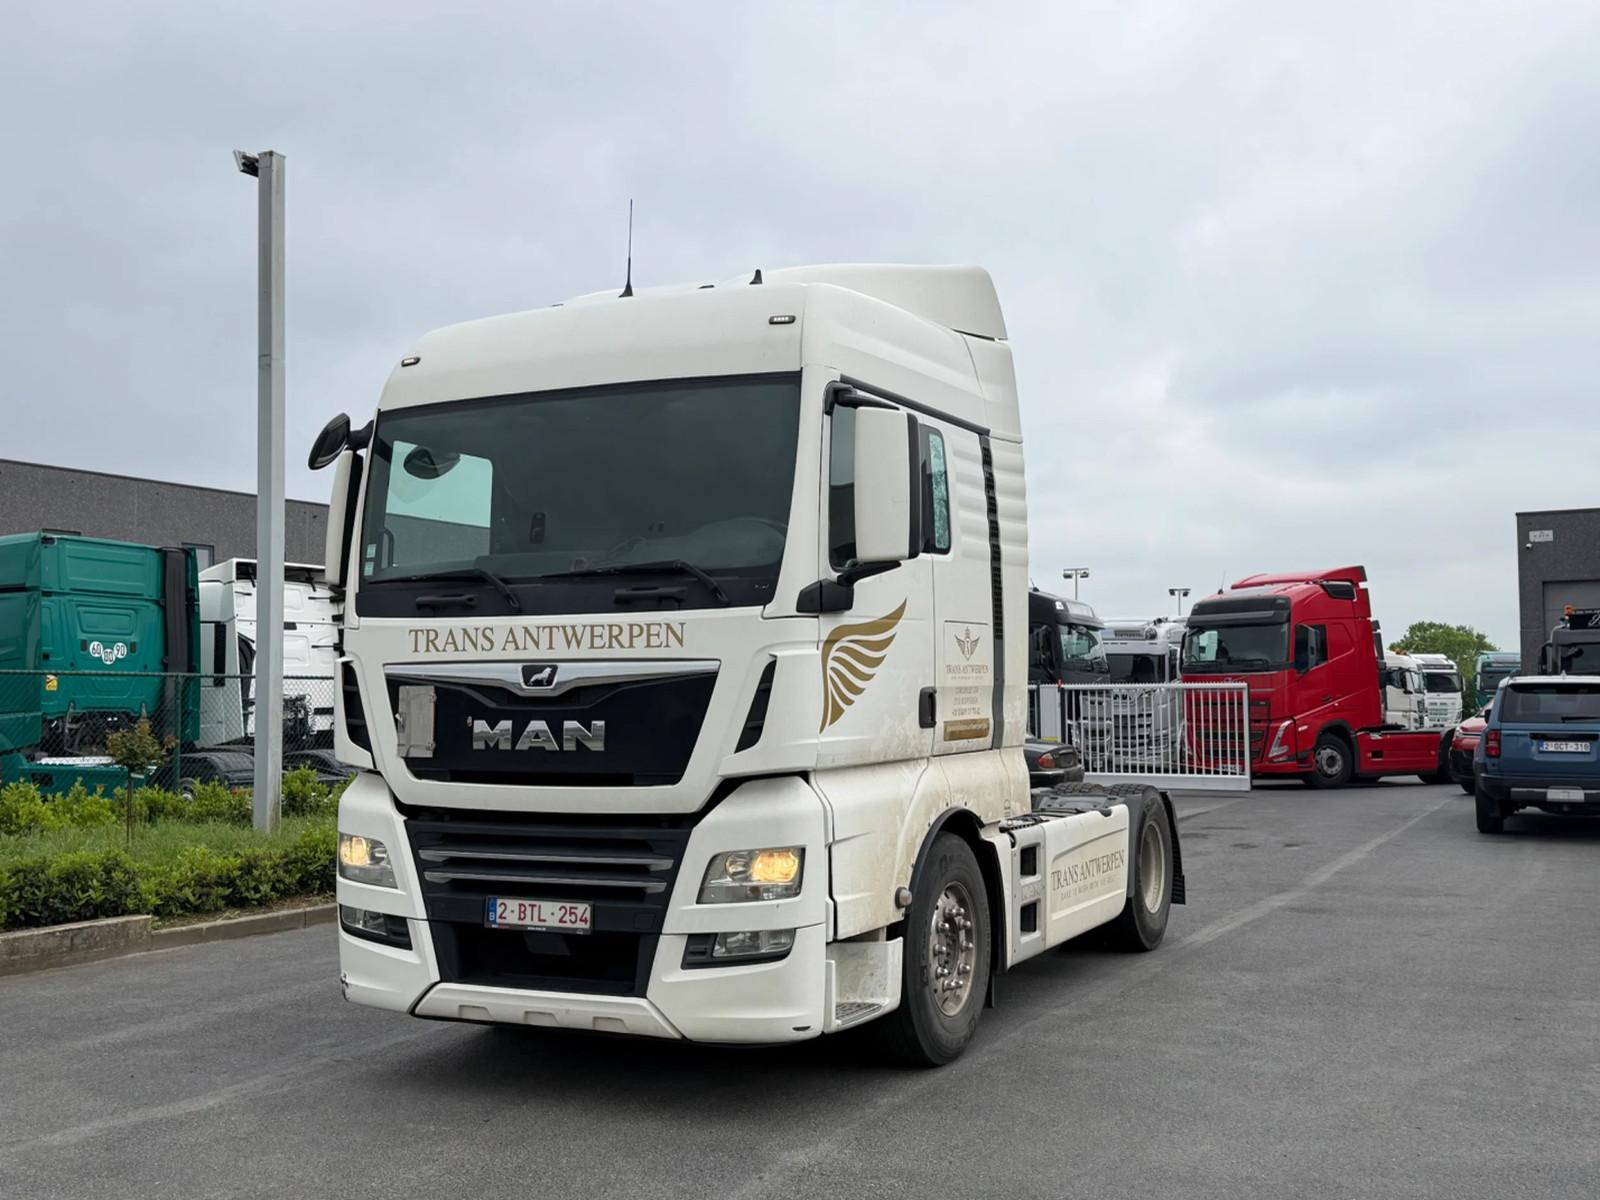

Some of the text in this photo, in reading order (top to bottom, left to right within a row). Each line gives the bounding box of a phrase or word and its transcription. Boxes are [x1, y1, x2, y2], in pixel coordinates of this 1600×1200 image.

[91, 643, 101, 655] 60
[115, 644, 125, 656] 90
[408, 622, 687, 653] TRANS ANTWERPEN
[472, 719, 605, 751] MAN
[1051, 864, 1079, 891] TRANS
[1080, 849, 1125, 881] ANTWERPEN
